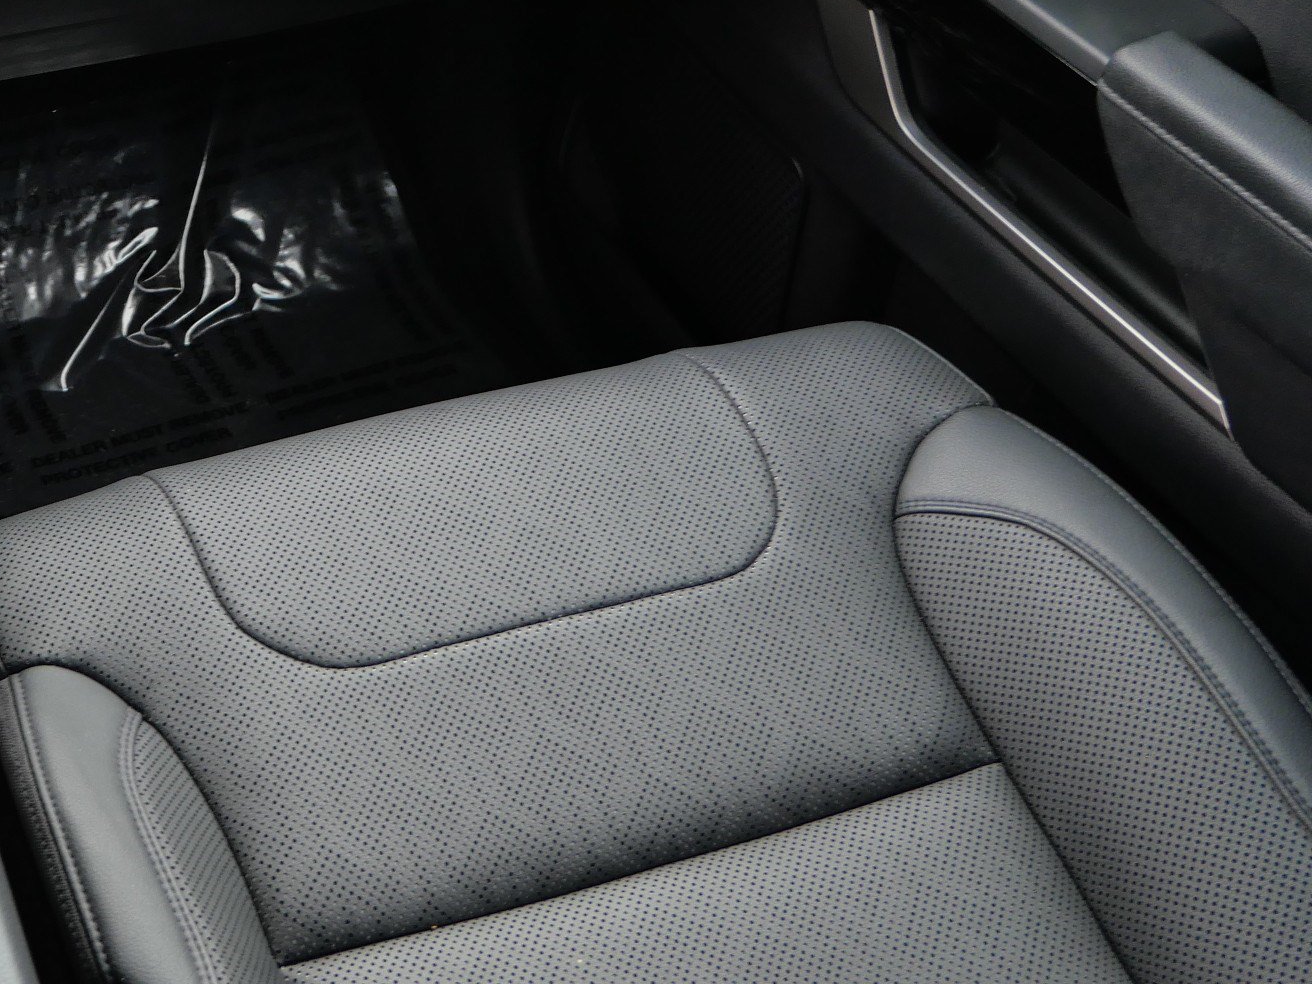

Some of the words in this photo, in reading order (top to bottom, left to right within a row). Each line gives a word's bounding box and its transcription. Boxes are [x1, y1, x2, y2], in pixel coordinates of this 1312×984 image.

[31, 437, 108, 470] DEALER
[109, 421, 164, 448] MUST
[168, 402, 249, 431] REMOVE
[40, 447, 158, 486] PROTECTIVE
[166, 427, 233, 455] COVER
